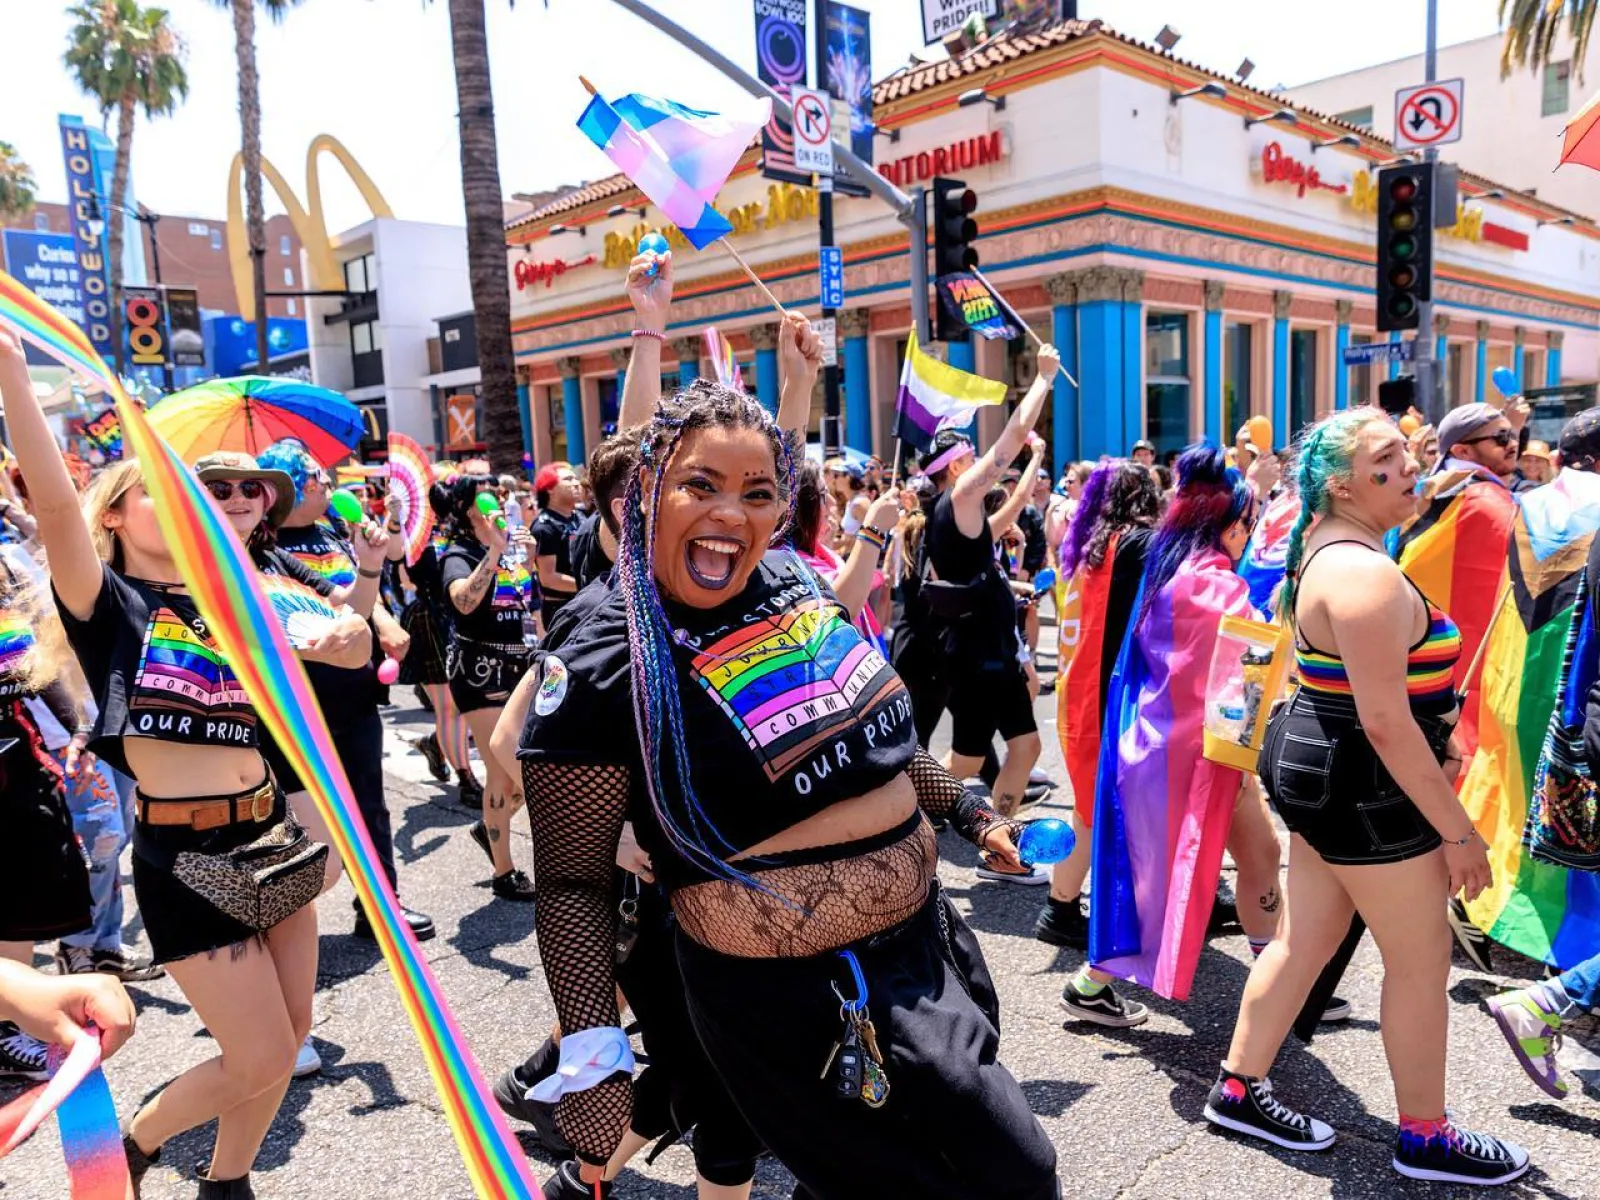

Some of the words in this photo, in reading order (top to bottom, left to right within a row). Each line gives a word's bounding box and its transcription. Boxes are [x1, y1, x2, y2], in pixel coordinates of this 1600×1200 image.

[877, 129, 1003, 187] DITORIUM
[496, 610, 520, 623] OUR
[152, 676, 250, 703] COMMUNI
[139, 713, 192, 735] OUR
[206, 721, 251, 744] PRIDE
[794, 740, 852, 796] OUR
[863, 693, 912, 750] PRIDE
